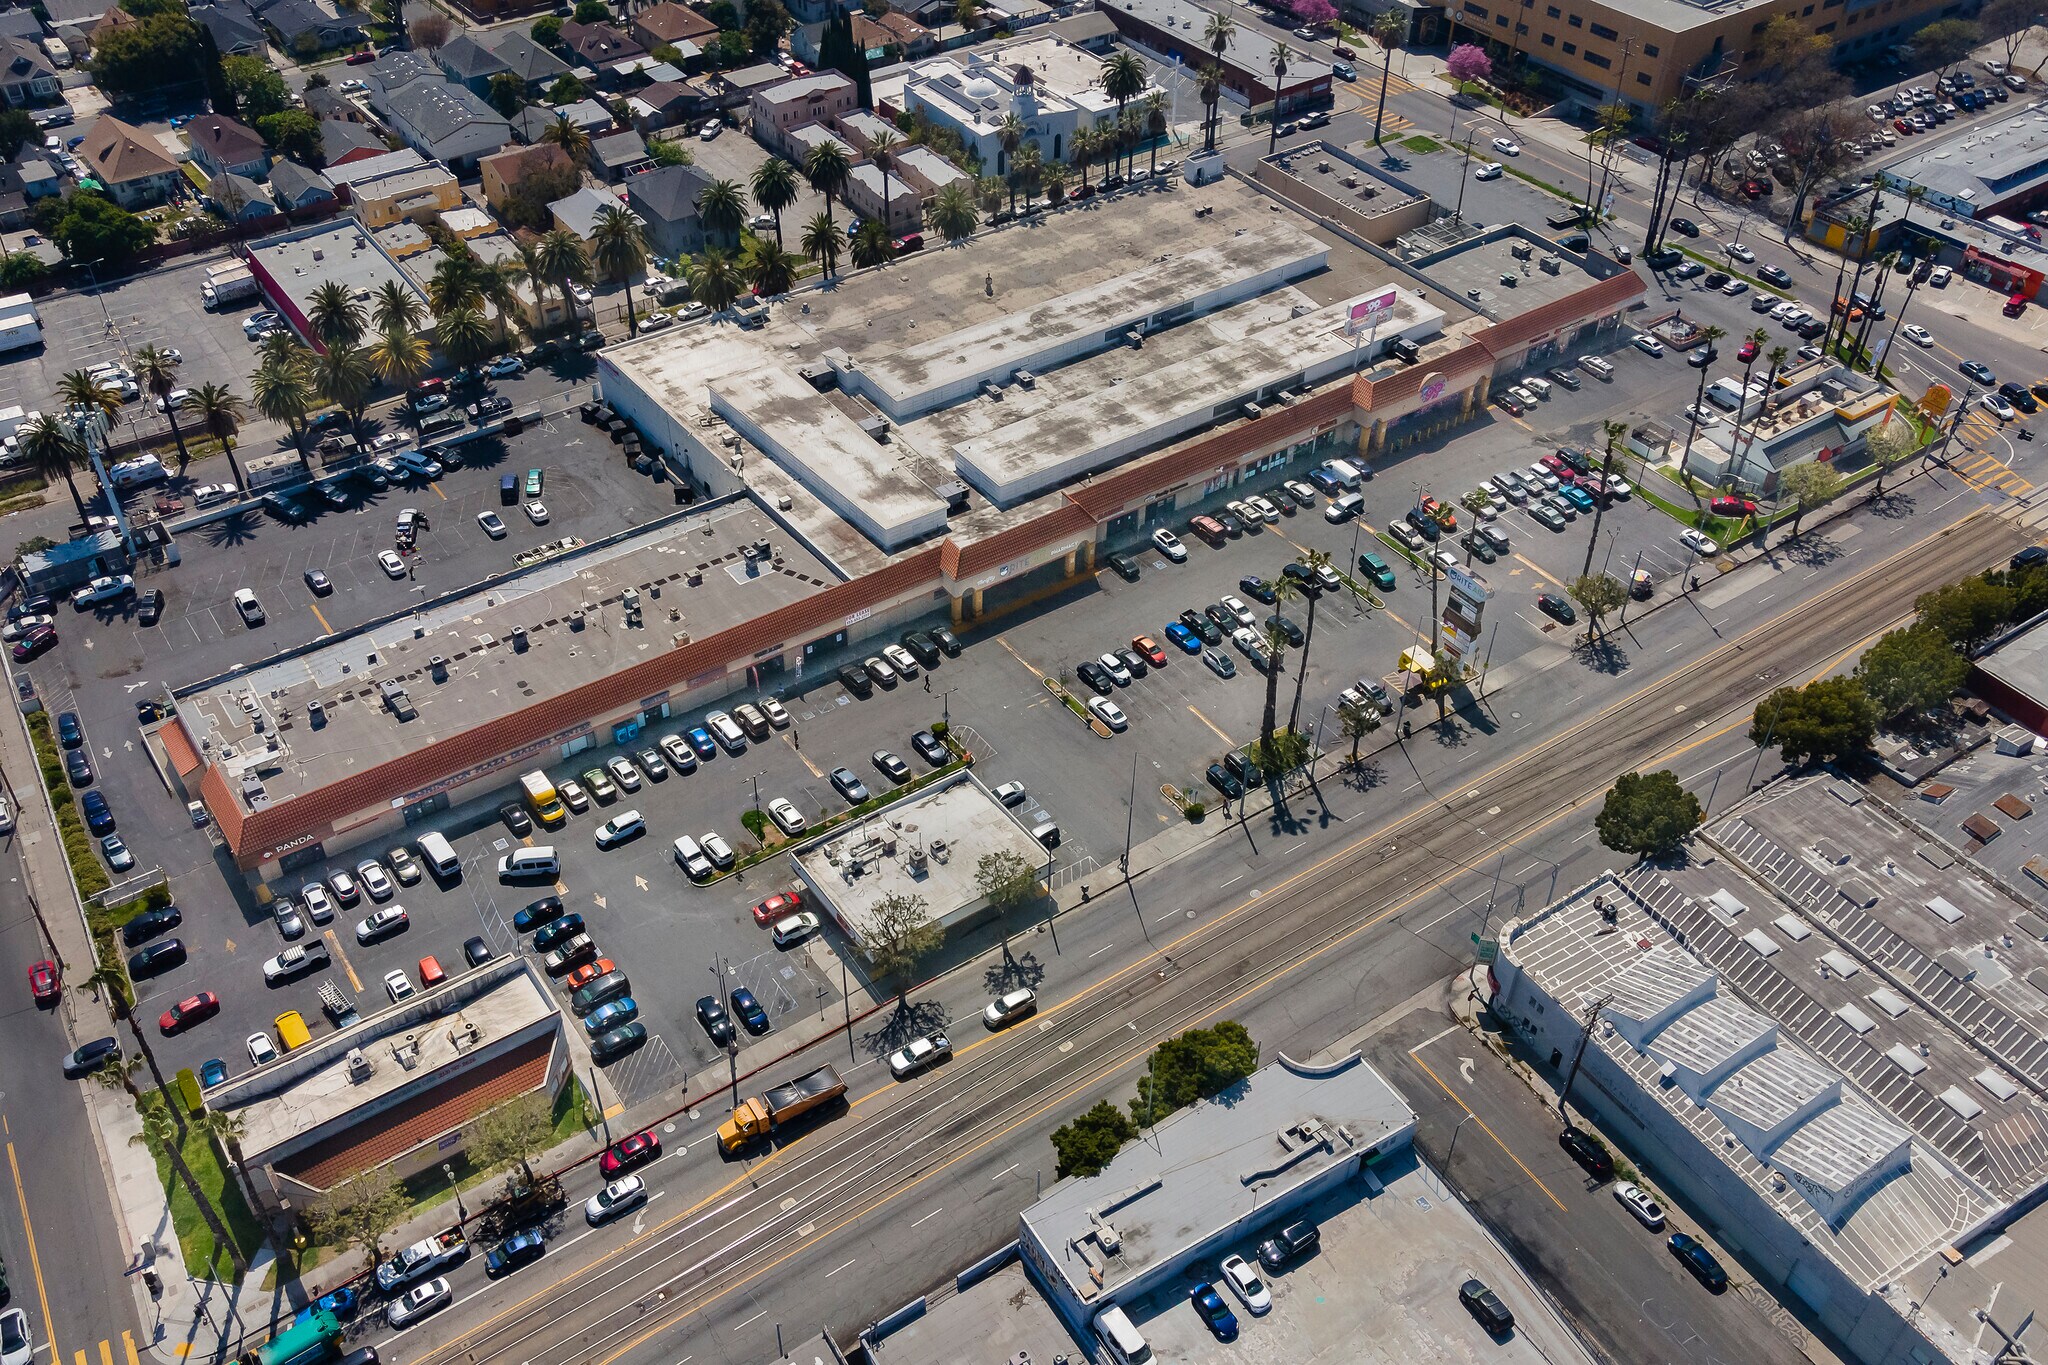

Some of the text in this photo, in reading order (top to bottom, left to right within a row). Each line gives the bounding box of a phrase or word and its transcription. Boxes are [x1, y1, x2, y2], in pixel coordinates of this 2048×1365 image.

[1051, 540, 1079, 556] PHARMACY
[1457, 575, 1472, 591] RITE
[1473, 587, 1485, 598] AID
[475, 757, 508, 774] PLAZA
[555, 722, 591, 741] CENTER
[276, 834, 315, 852] PANDA
